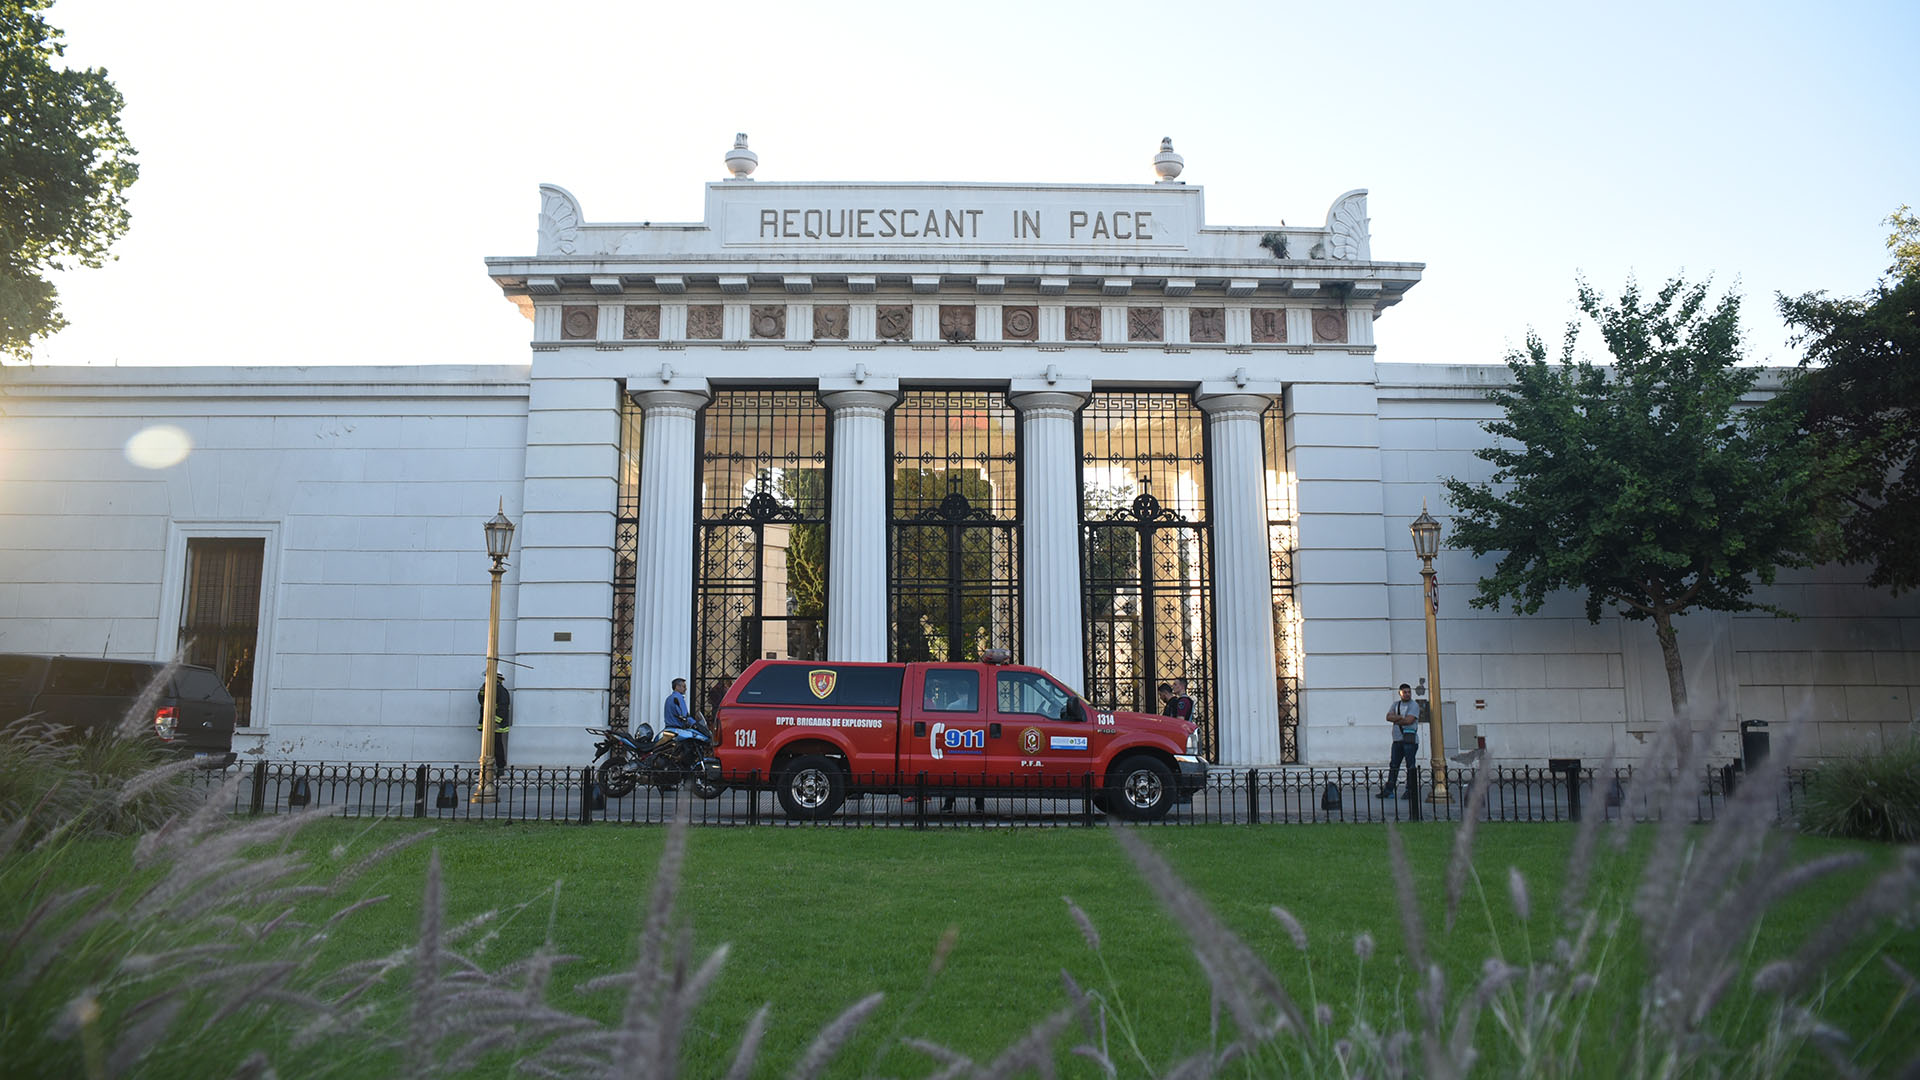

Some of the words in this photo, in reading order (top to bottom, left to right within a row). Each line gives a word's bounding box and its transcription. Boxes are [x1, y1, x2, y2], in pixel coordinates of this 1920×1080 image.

[760, 209, 983, 239] REQUIESCANT
[1013, 210, 1041, 239] IN
[1069, 210, 1153, 240] PACE
[776, 716, 796, 726] DPTO.
[796, 717, 831, 727] BRIGADAS
[832, 718, 841, 727] DE
[841, 718, 882, 728] EXPLOSIVOS
[1097, 713, 1115, 725] 1314
[734, 729, 757, 747] 1314
[944, 728, 985, 748] 911
